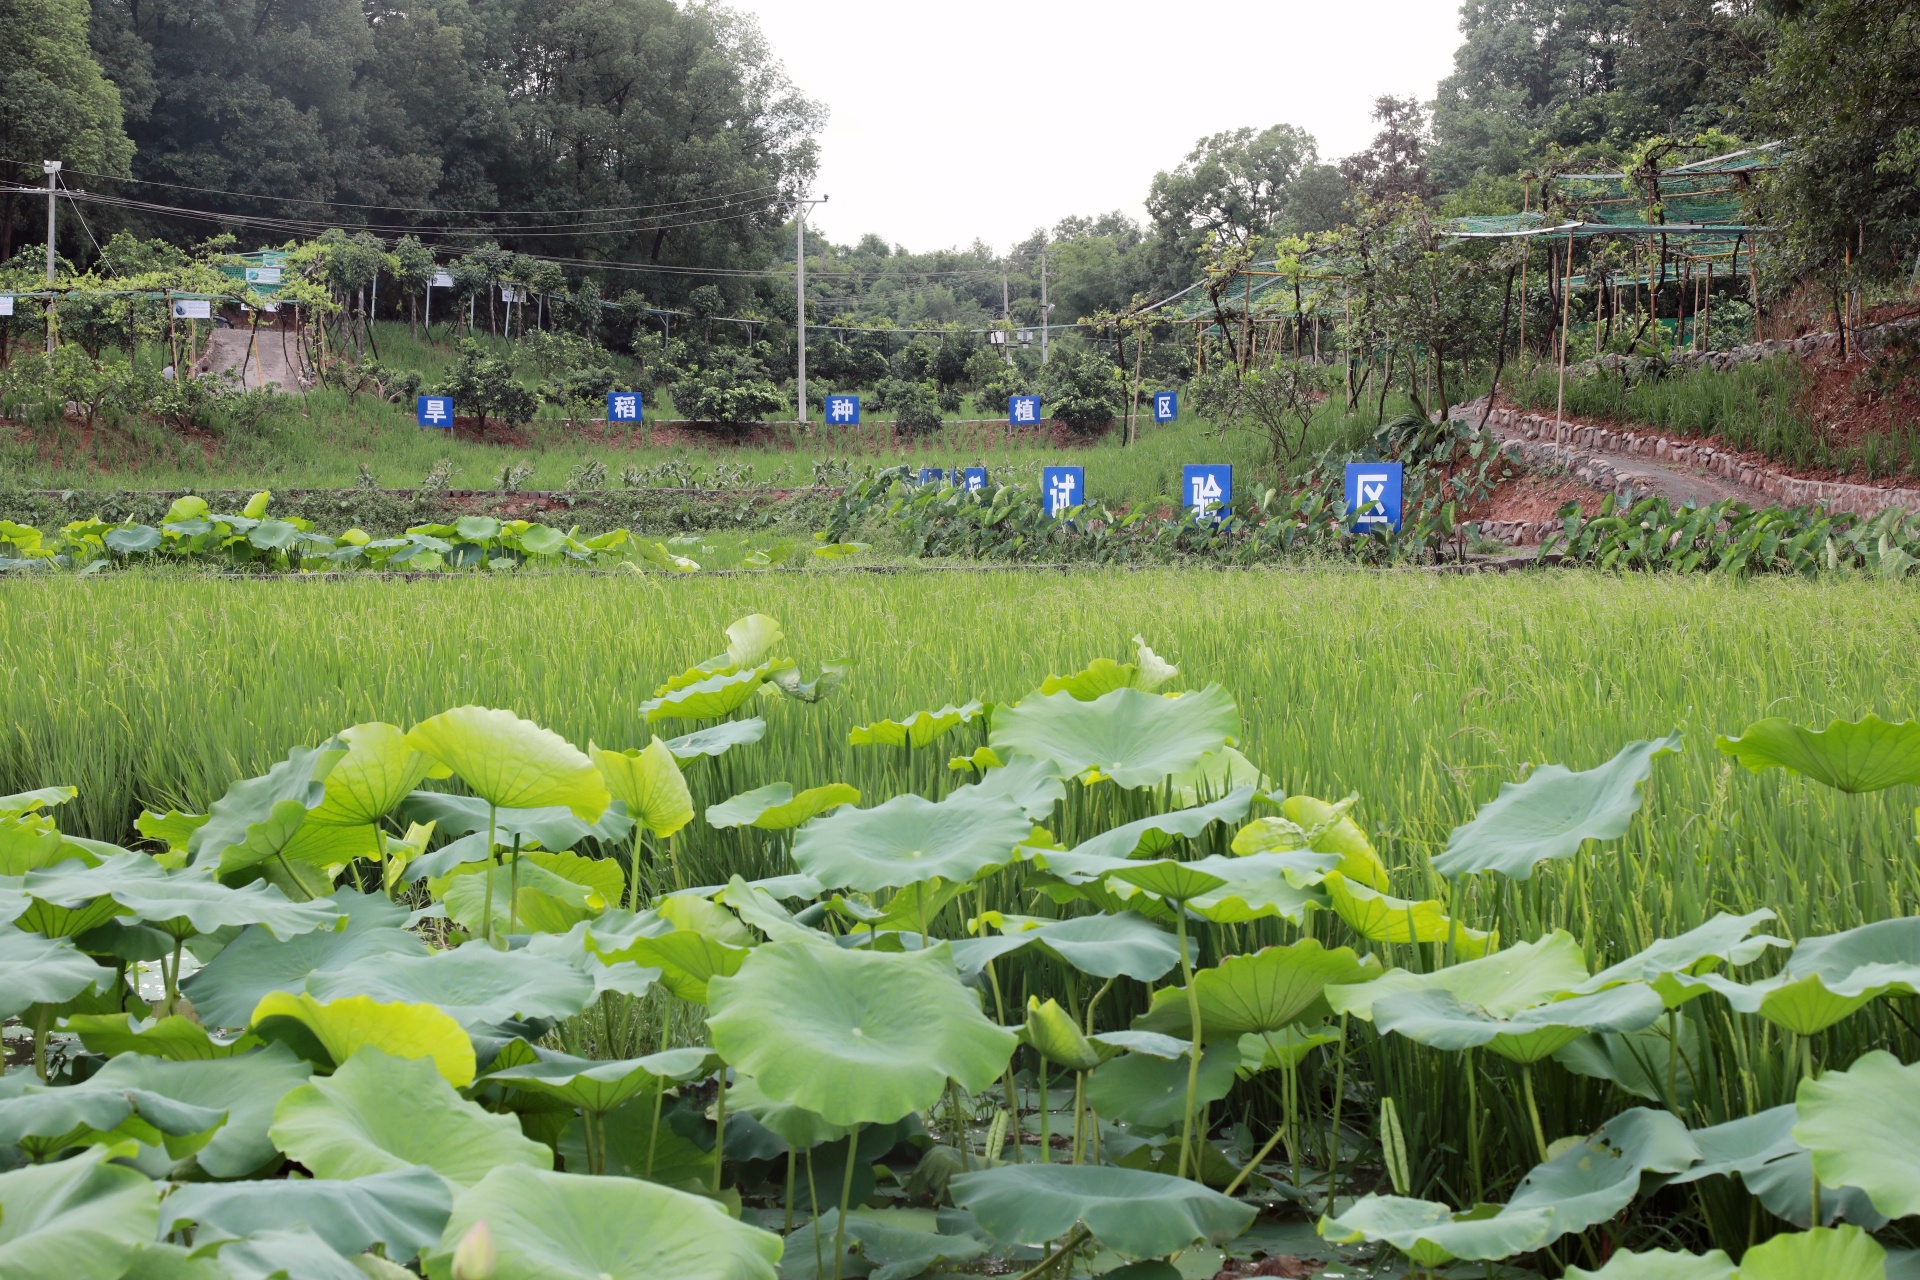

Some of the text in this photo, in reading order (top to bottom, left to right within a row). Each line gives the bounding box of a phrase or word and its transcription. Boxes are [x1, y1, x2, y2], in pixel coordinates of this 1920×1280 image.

[424, 396, 1172, 424] 旱 稻 种 植 区
[1049, 473, 1388, 524] 试 验 区
